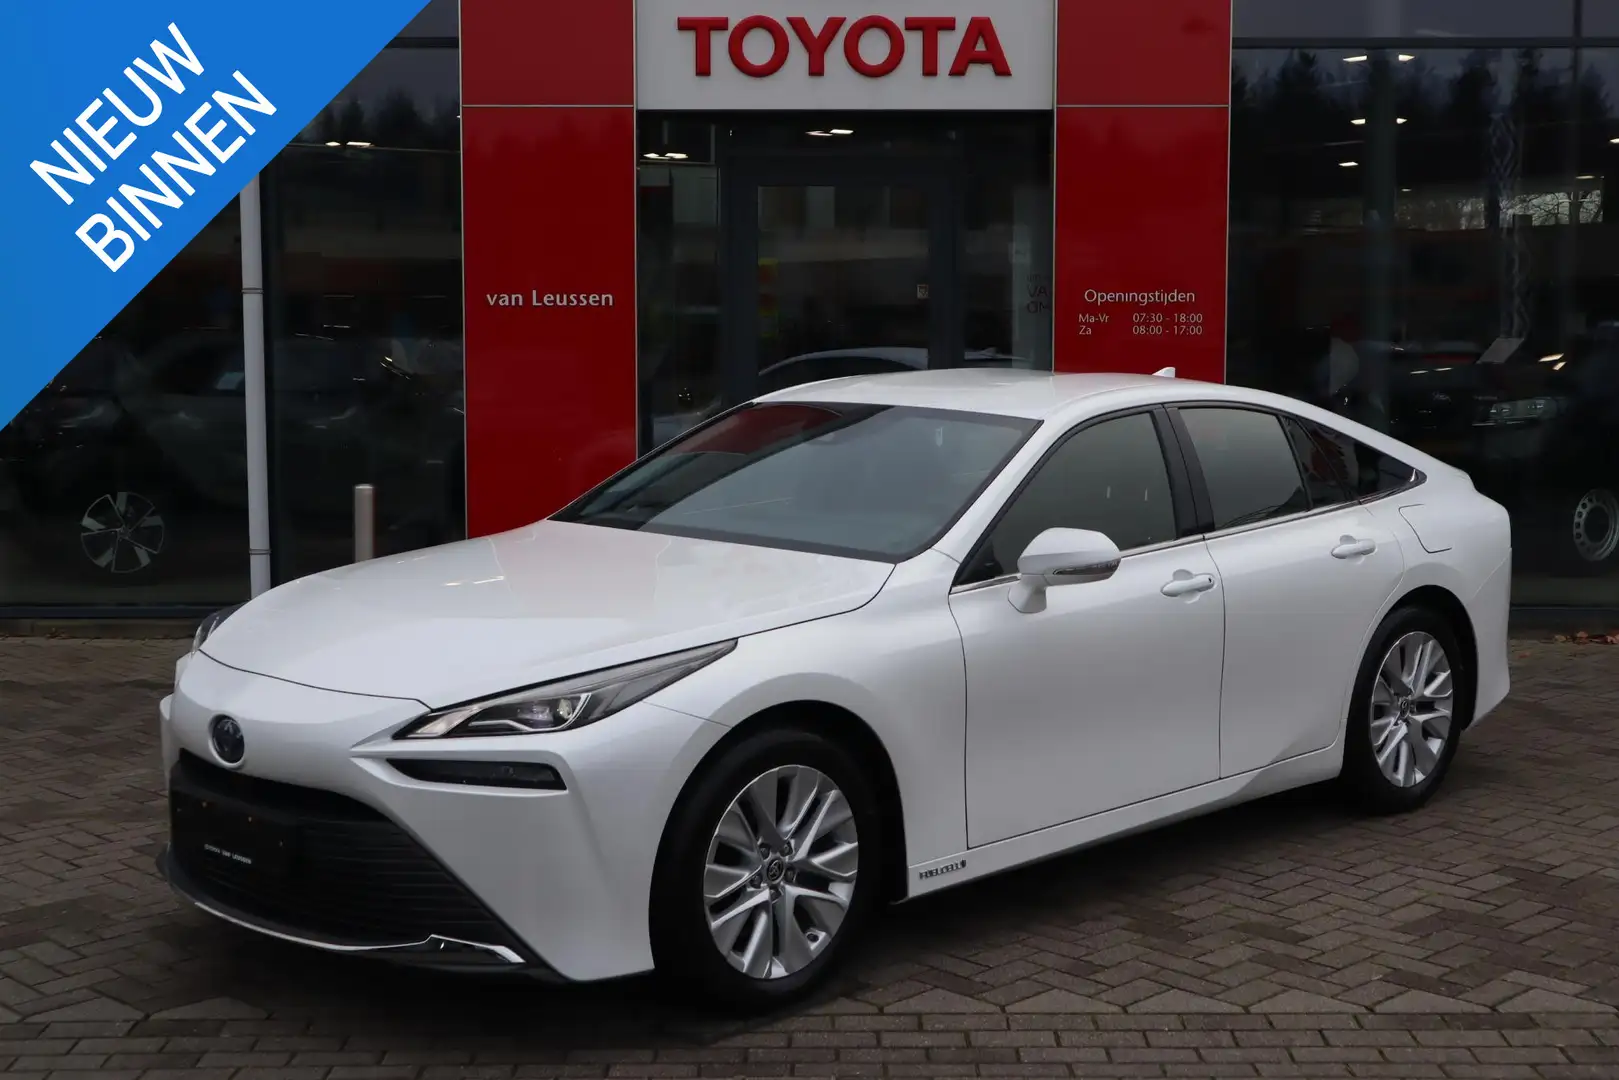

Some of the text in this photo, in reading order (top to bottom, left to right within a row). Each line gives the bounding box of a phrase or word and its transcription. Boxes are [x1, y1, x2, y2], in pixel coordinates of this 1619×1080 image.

[677, 15, 1012, 77] TOYOTA
[486, 289, 614, 306] van Leussen
[1084, 288, 1196, 306] Openingstijden
[1078, 312, 1110, 323] Ma-Vr
[1132, 312, 1163, 323] 07:30
[1174, 312, 1203, 323] 18:00
[1079, 325, 1092, 335] Za
[1132, 325, 1163, 335] 08:00
[1174, 325, 1203, 335] 17:00
